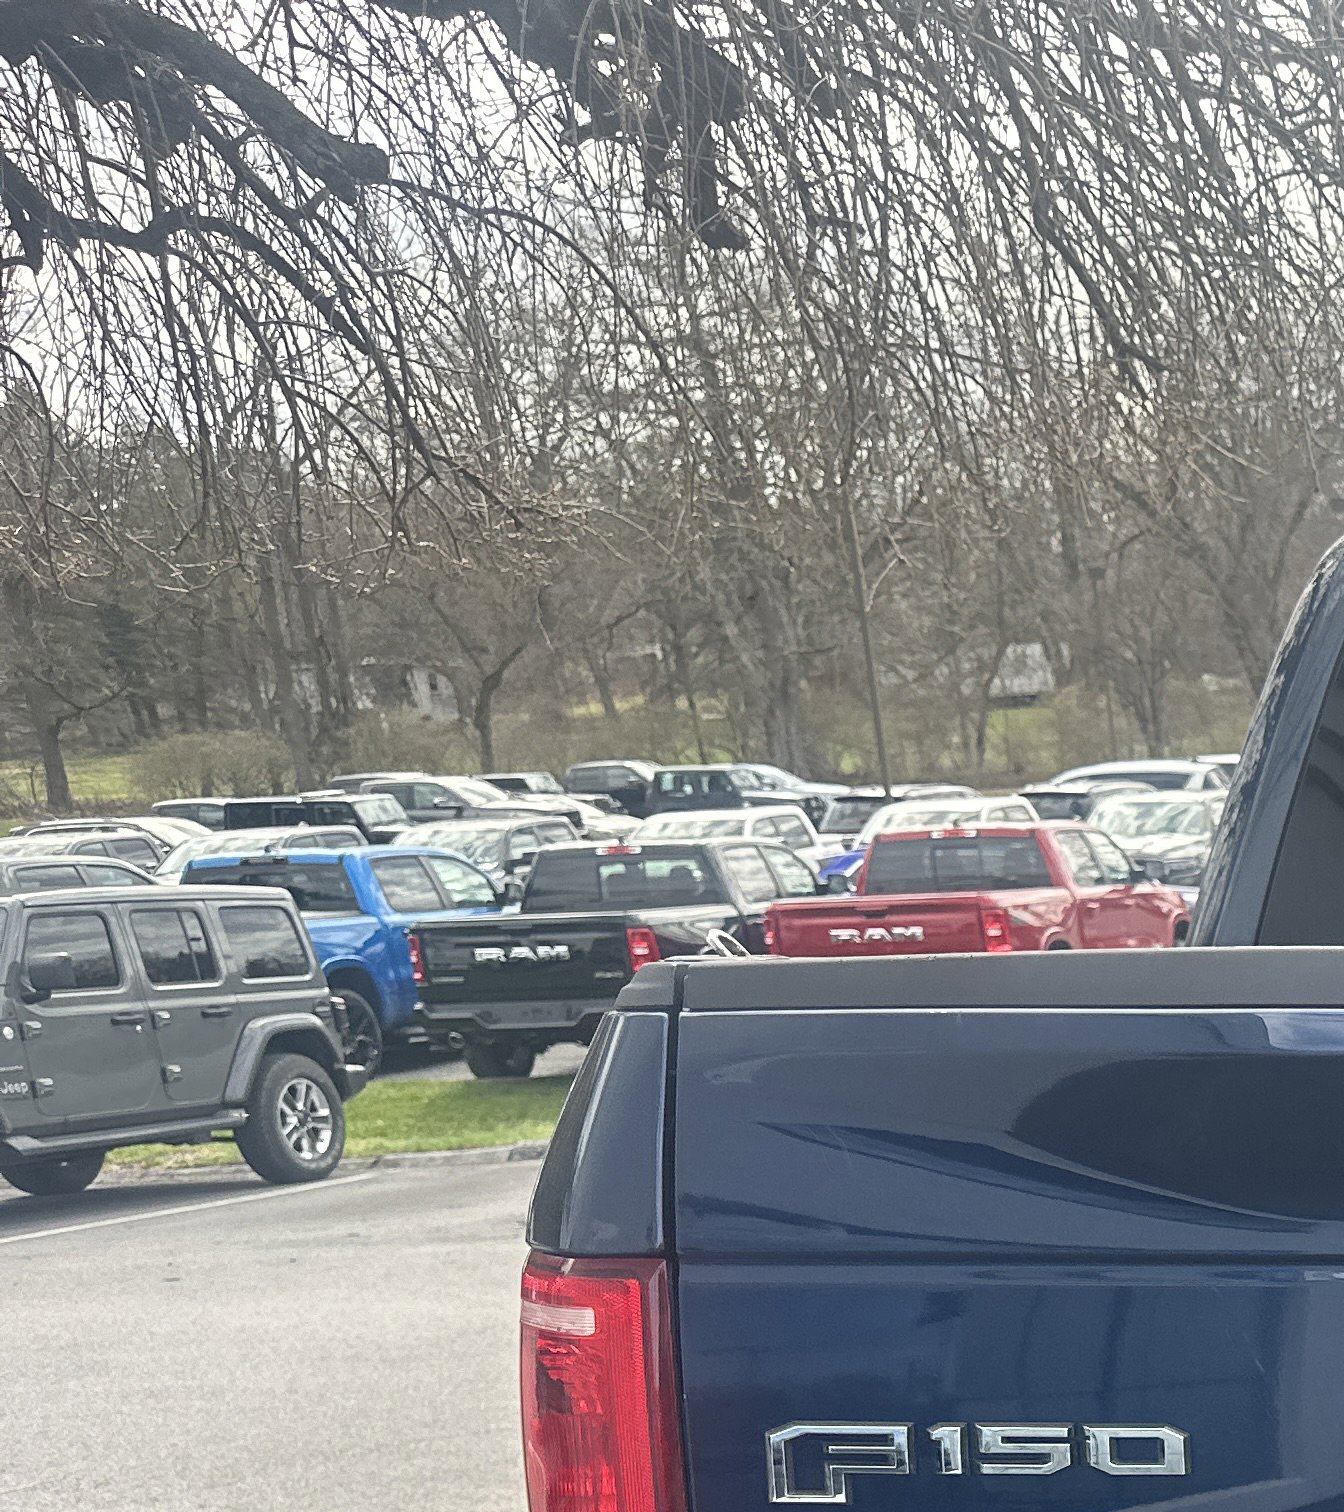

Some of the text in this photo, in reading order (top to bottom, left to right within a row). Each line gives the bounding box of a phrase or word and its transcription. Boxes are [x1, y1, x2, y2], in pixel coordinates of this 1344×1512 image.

[827, 926, 925, 943] RAM
[473, 945, 571, 963] RAM
[0, 1081, 29, 1095] Jeep
